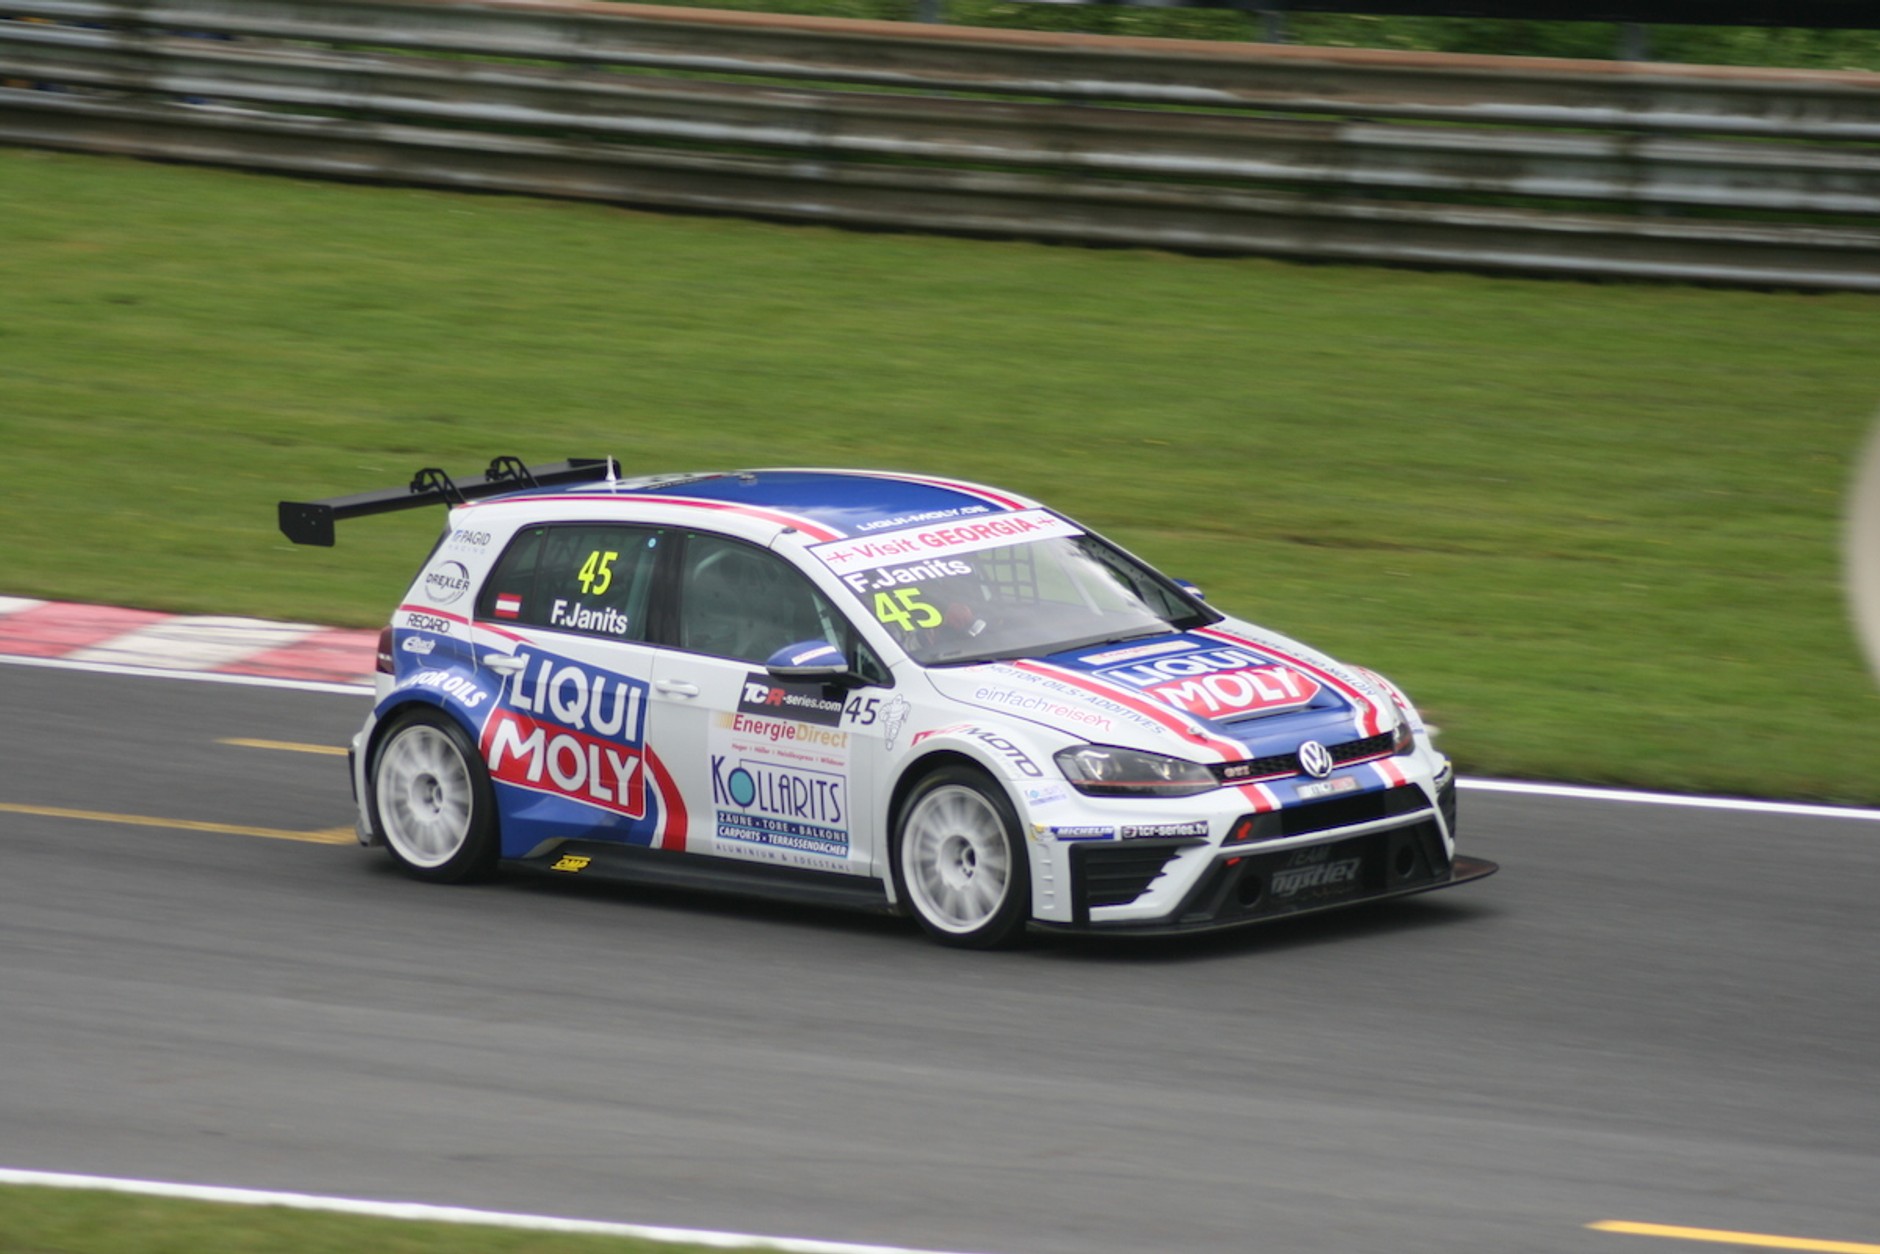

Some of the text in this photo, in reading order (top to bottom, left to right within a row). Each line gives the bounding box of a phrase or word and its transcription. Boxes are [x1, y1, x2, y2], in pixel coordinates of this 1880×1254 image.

[851, 517, 1040, 558] Visit GEORGIA
[426, 573, 471, 591] DREXLER
[578, 550, 619, 595] 45
[843, 558, 972, 593] F.Janits
[406, 612, 451, 634] RECARO
[550, 599, 628, 634] F.Janits
[873, 587, 943, 632] 45
[1108, 650, 1265, 686] LIQUI
[442, 676, 488, 708] OILS
[509, 653, 642, 742] LIQUI
[987, 664, 1166, 734] MOTOR OILS ADDITIVES
[1154, 666, 1300, 712] MOLY
[844, 696, 881, 726] 45
[974, 686, 1111, 733] einfachreisen
[732, 713, 848, 748] EnergieDirect
[488, 718, 640, 807] MOLY
[711, 754, 842, 823] KOLLARITS
[719, 826, 761, 841] CARPORTS
[763, 819, 789, 832] TORE
[1057, 826, 1114, 836] MICHELIN
[716, 843, 775, 859] ALUMINIUM
